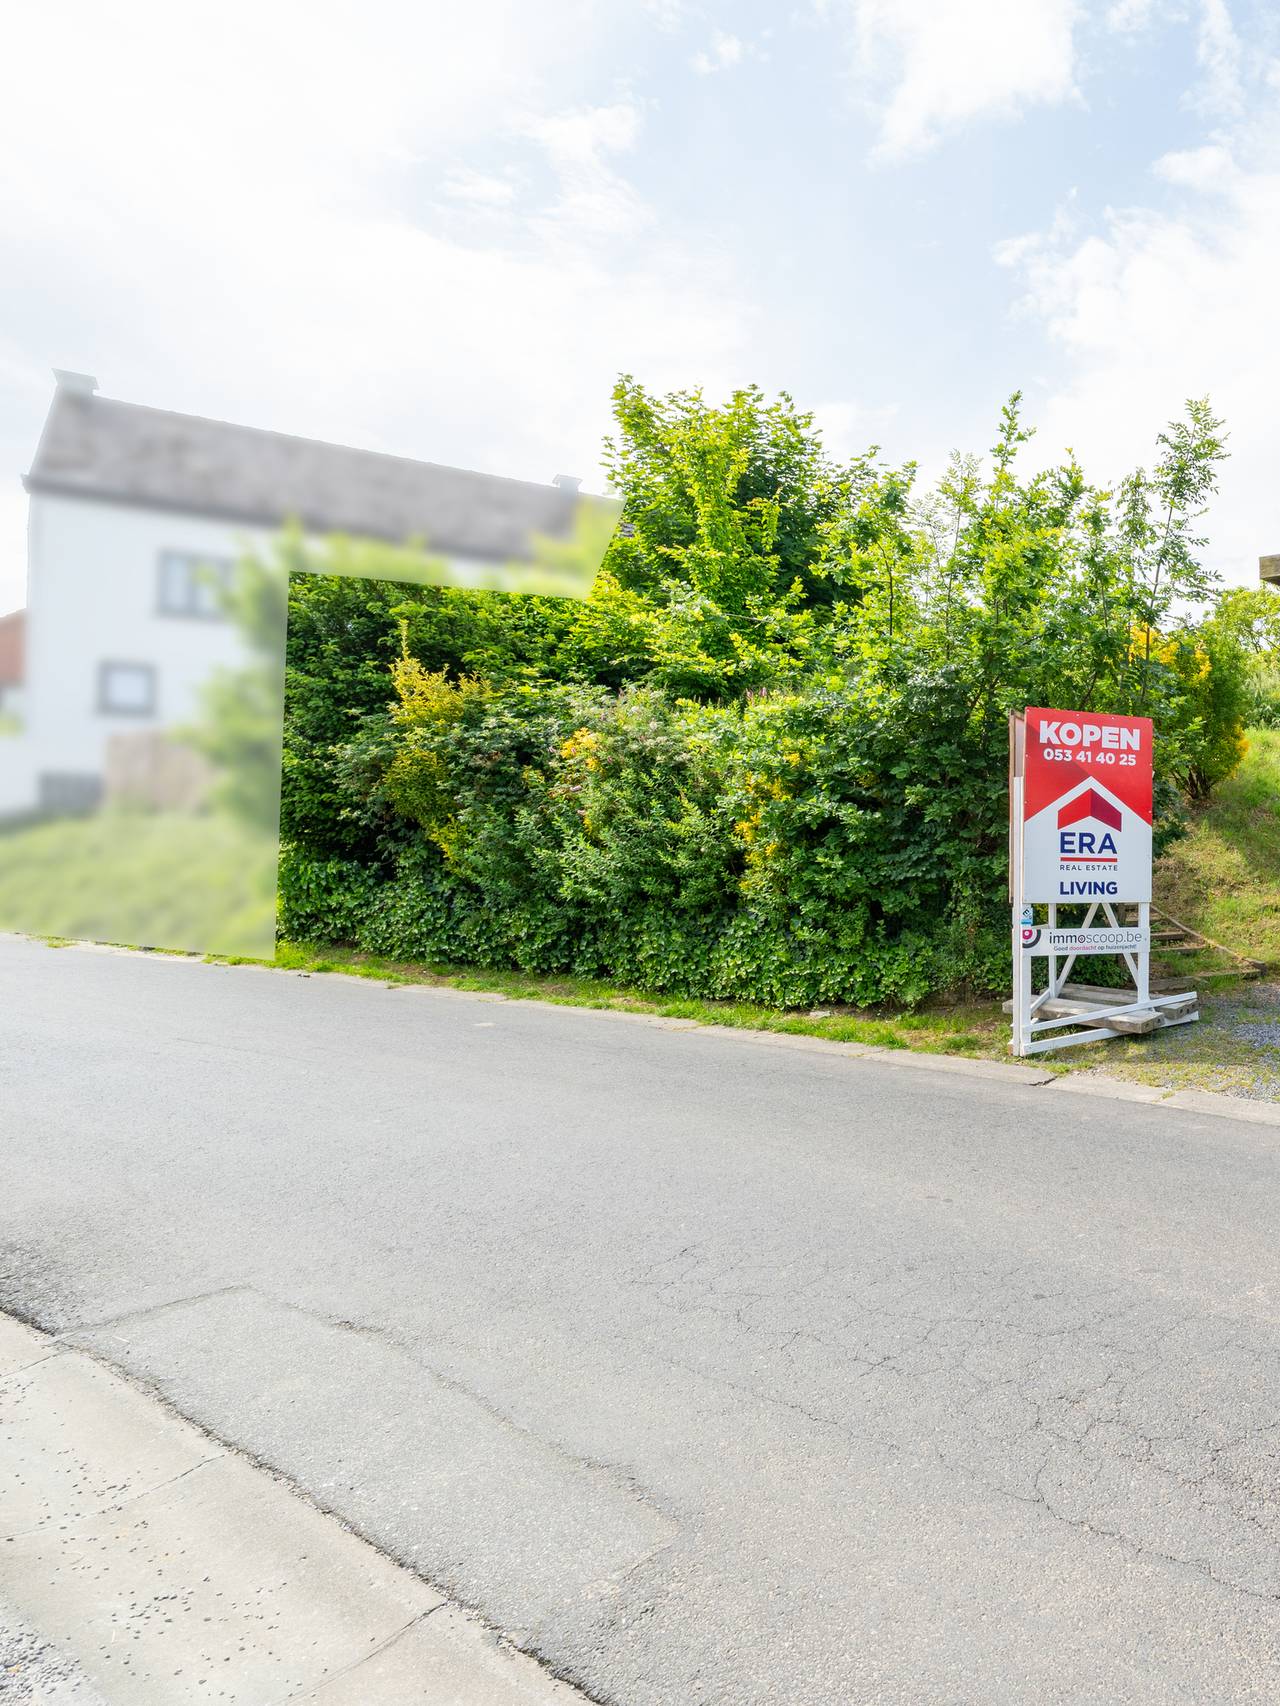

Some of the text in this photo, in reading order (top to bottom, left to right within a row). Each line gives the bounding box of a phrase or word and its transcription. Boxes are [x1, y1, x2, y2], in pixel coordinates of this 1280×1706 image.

[1039, 720, 1140, 751] KOPEN
[1043, 748, 1137, 766] 053 41 40 25
[1060, 832, 1118, 854] ERA
[1060, 881, 1118, 895] LIVING
[1049, 931, 1142, 944] immoscoop.be
